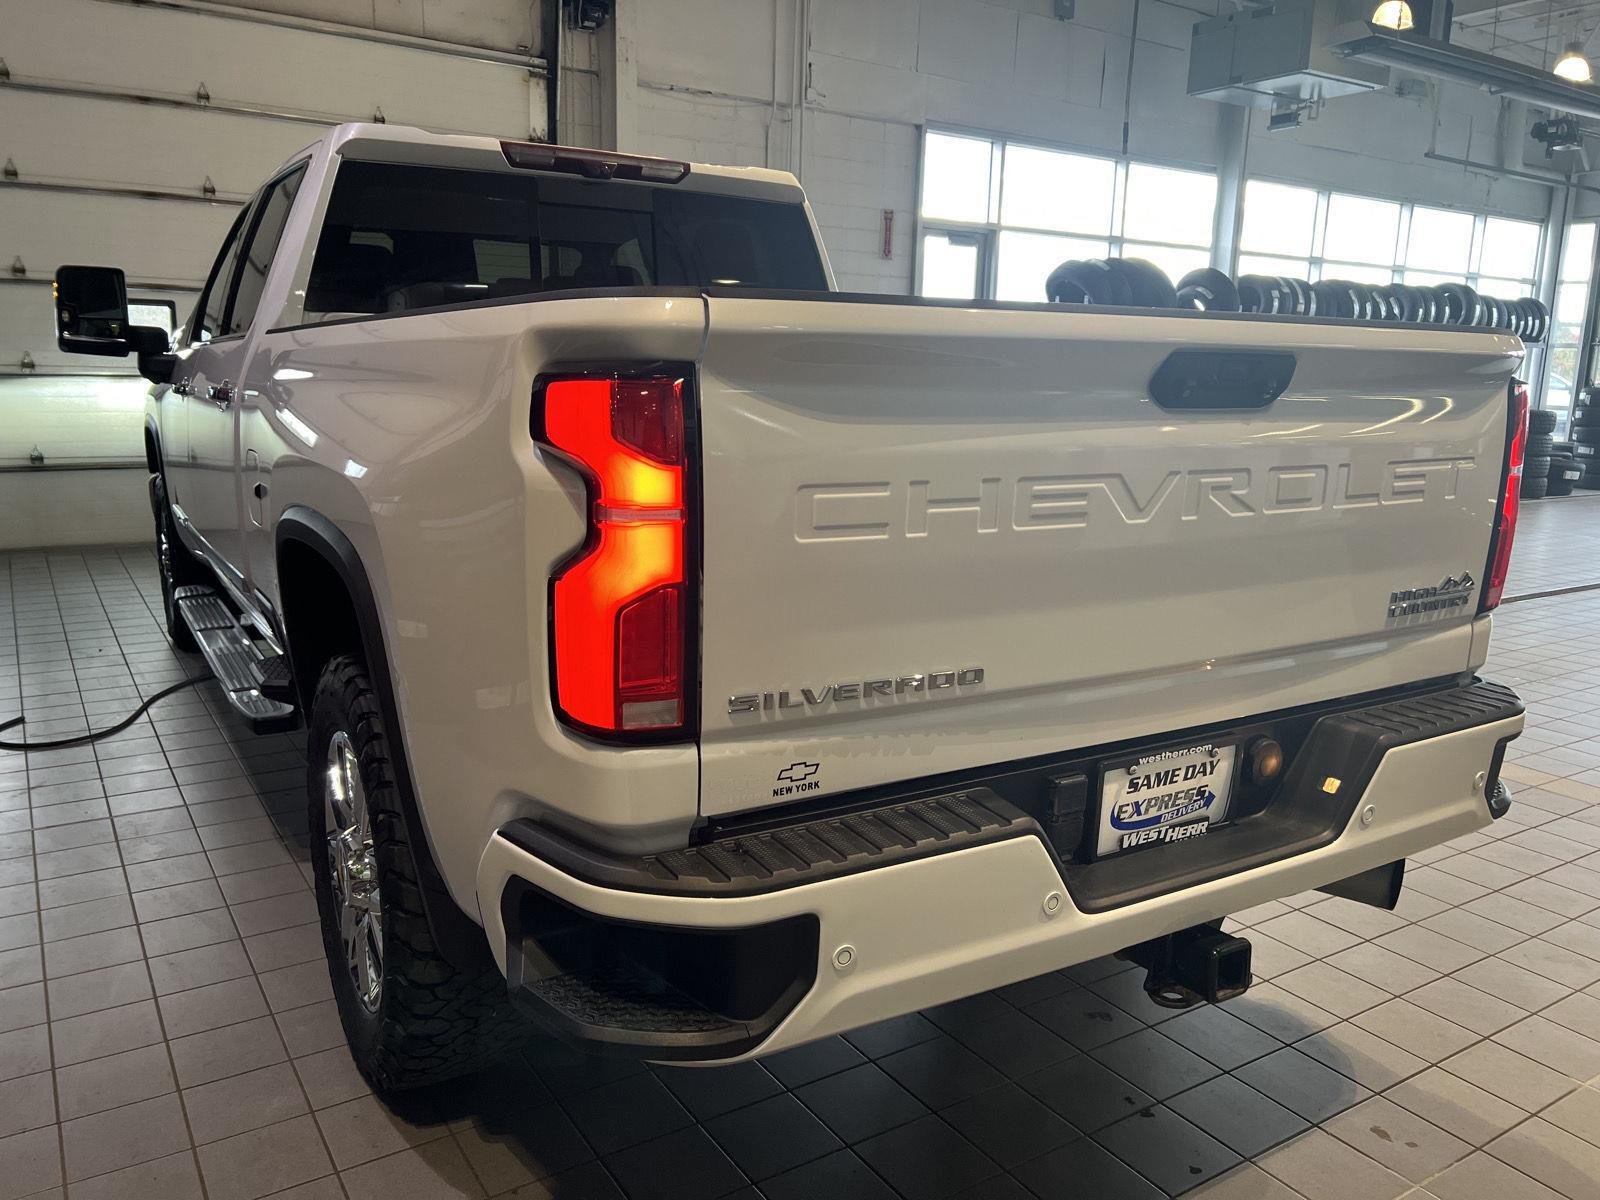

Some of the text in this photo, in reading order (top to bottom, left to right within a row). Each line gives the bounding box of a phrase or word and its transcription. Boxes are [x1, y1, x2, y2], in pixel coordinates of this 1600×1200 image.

[795, 457, 1475, 542] CHEVROLET
[728, 668, 985, 714] SILVERADO
[1139, 744, 1212, 765] westherr.com
[772, 780, 820, 798] NEW YORK
[1126, 758, 1220, 795] SAME DAY
[1117, 784, 1209, 820] EXPRESS
[1160, 800, 1206, 823] DELIVERY
